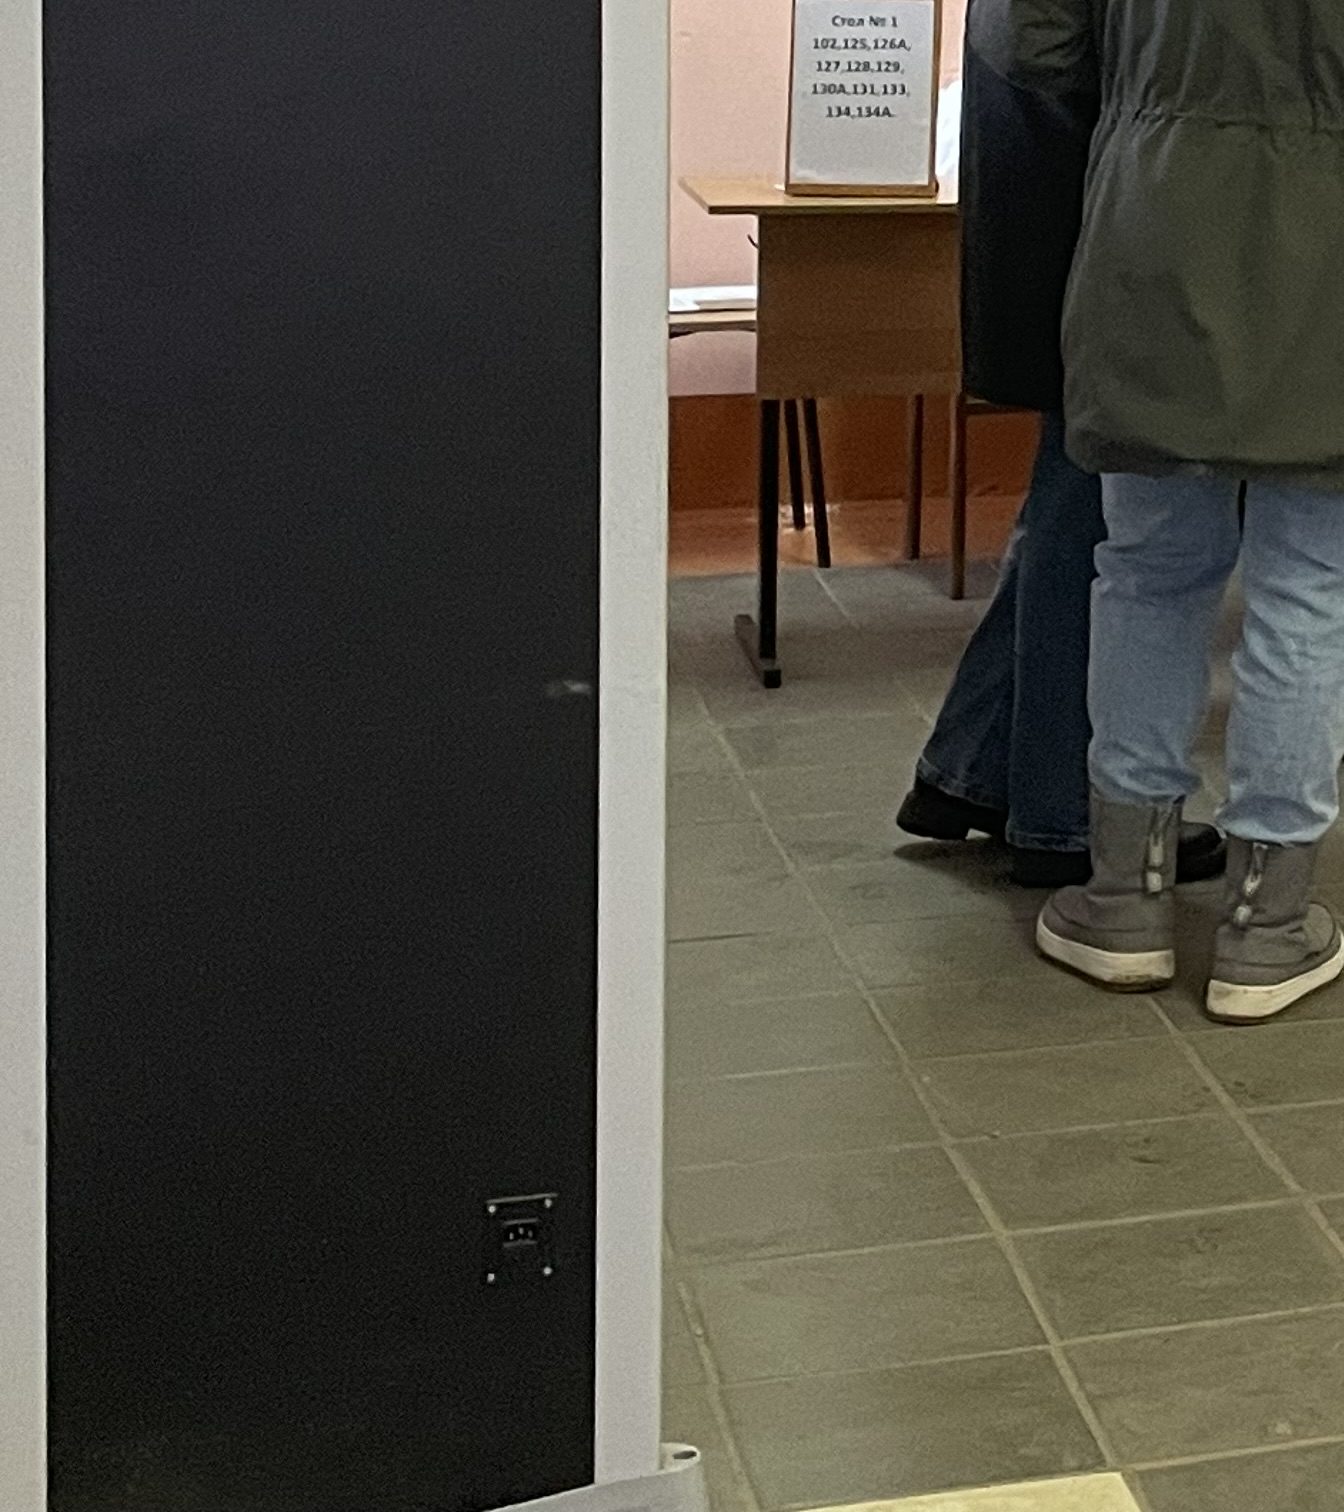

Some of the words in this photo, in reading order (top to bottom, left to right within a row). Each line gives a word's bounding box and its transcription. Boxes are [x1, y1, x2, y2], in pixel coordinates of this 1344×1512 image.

[831, 15, 865, 28] Стол
[869, 15, 886, 27] №
[891, 16, 898, 28] 1
